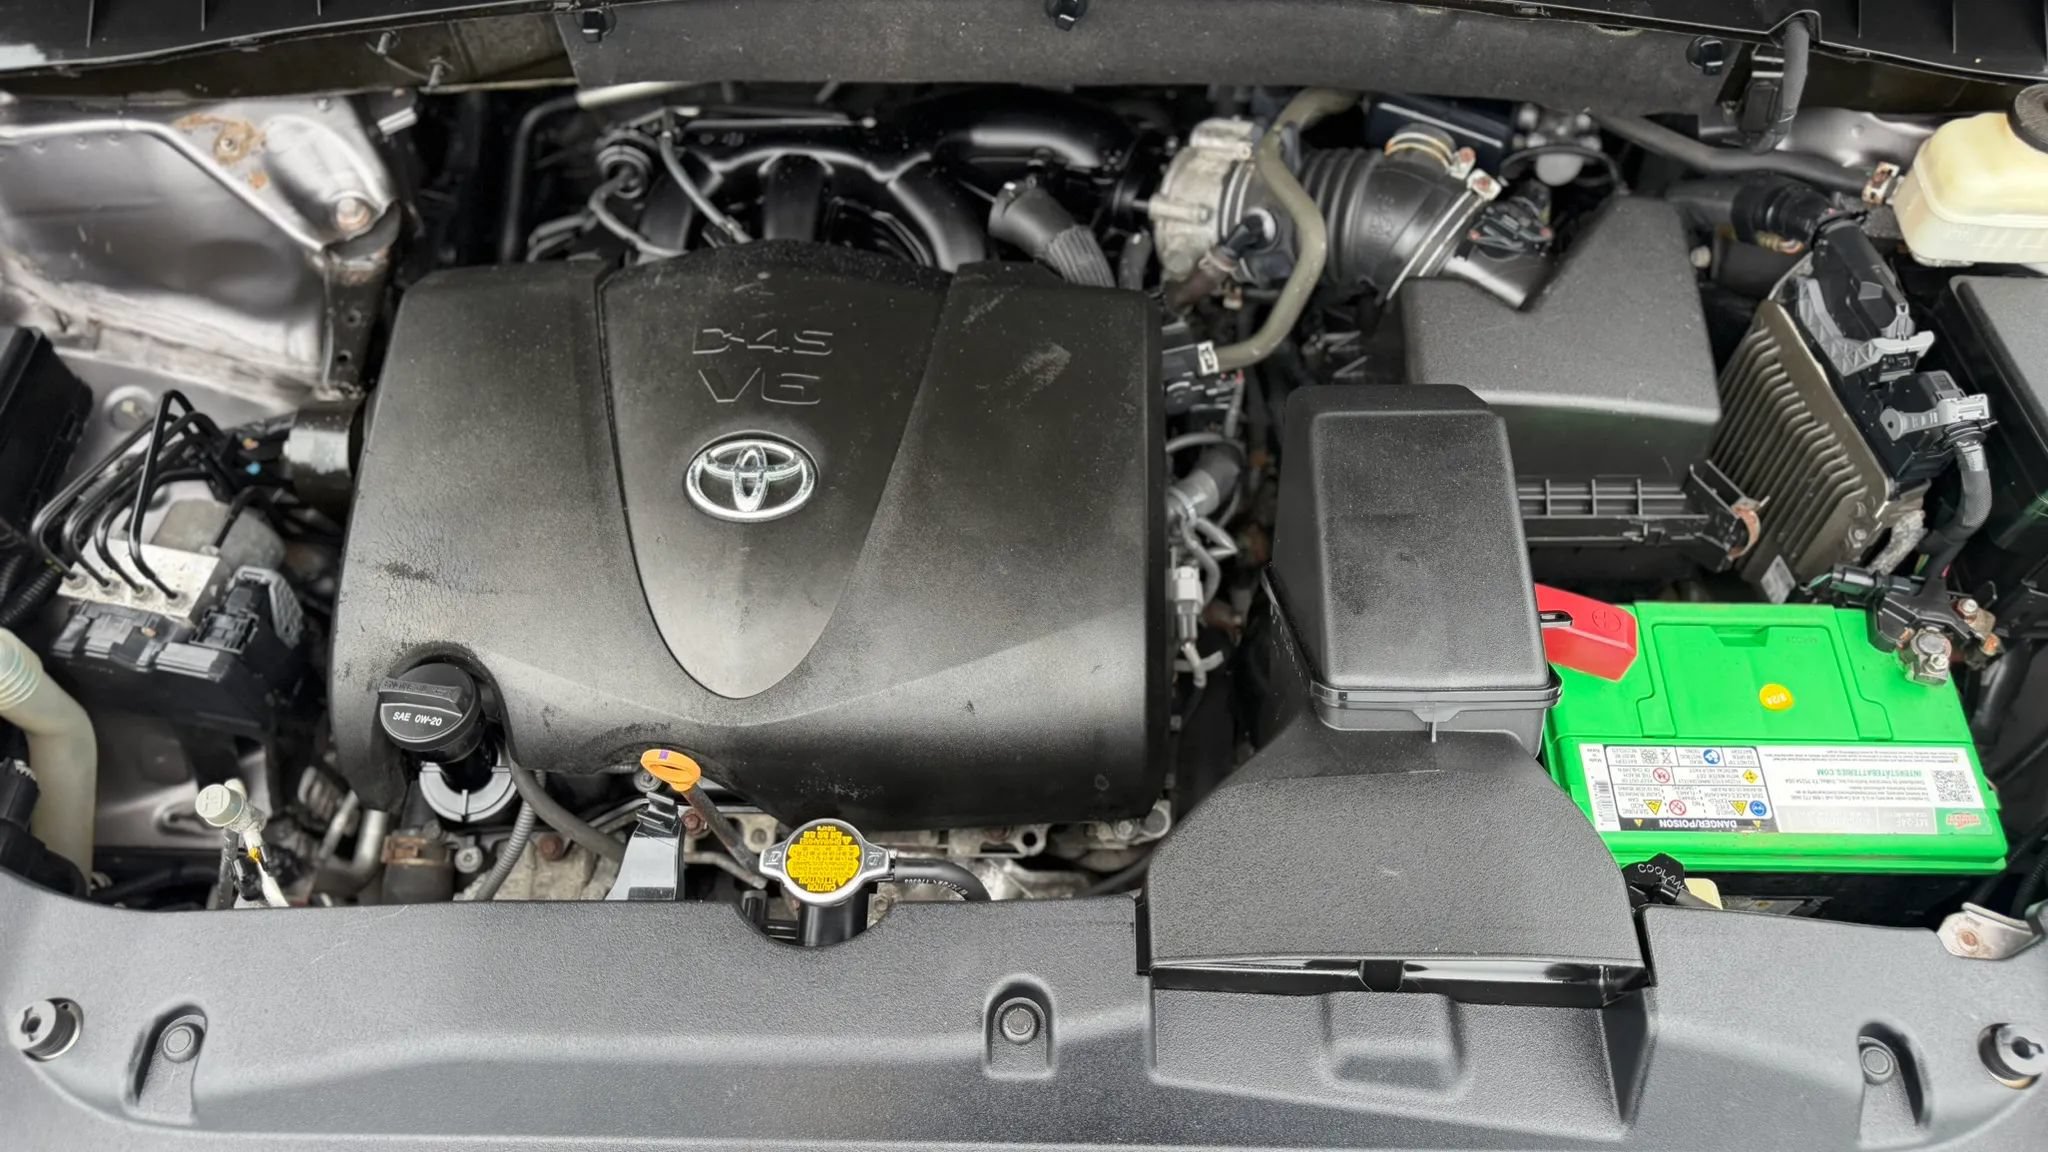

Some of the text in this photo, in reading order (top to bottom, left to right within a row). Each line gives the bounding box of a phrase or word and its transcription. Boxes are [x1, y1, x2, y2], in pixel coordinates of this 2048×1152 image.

[691, 327, 834, 357] D-4S
[697, 366, 822, 406] V6
[392, 711, 443, 727] SAE 0W-20
[1817, 768, 1922, 777] INTERSTATEBATTERIES.COM
[1659, 819, 1738, 829] DANGER/POISON
[1637, 863, 1686, 890] COOLAN
[806, 883, 837, 892] CAUTION
